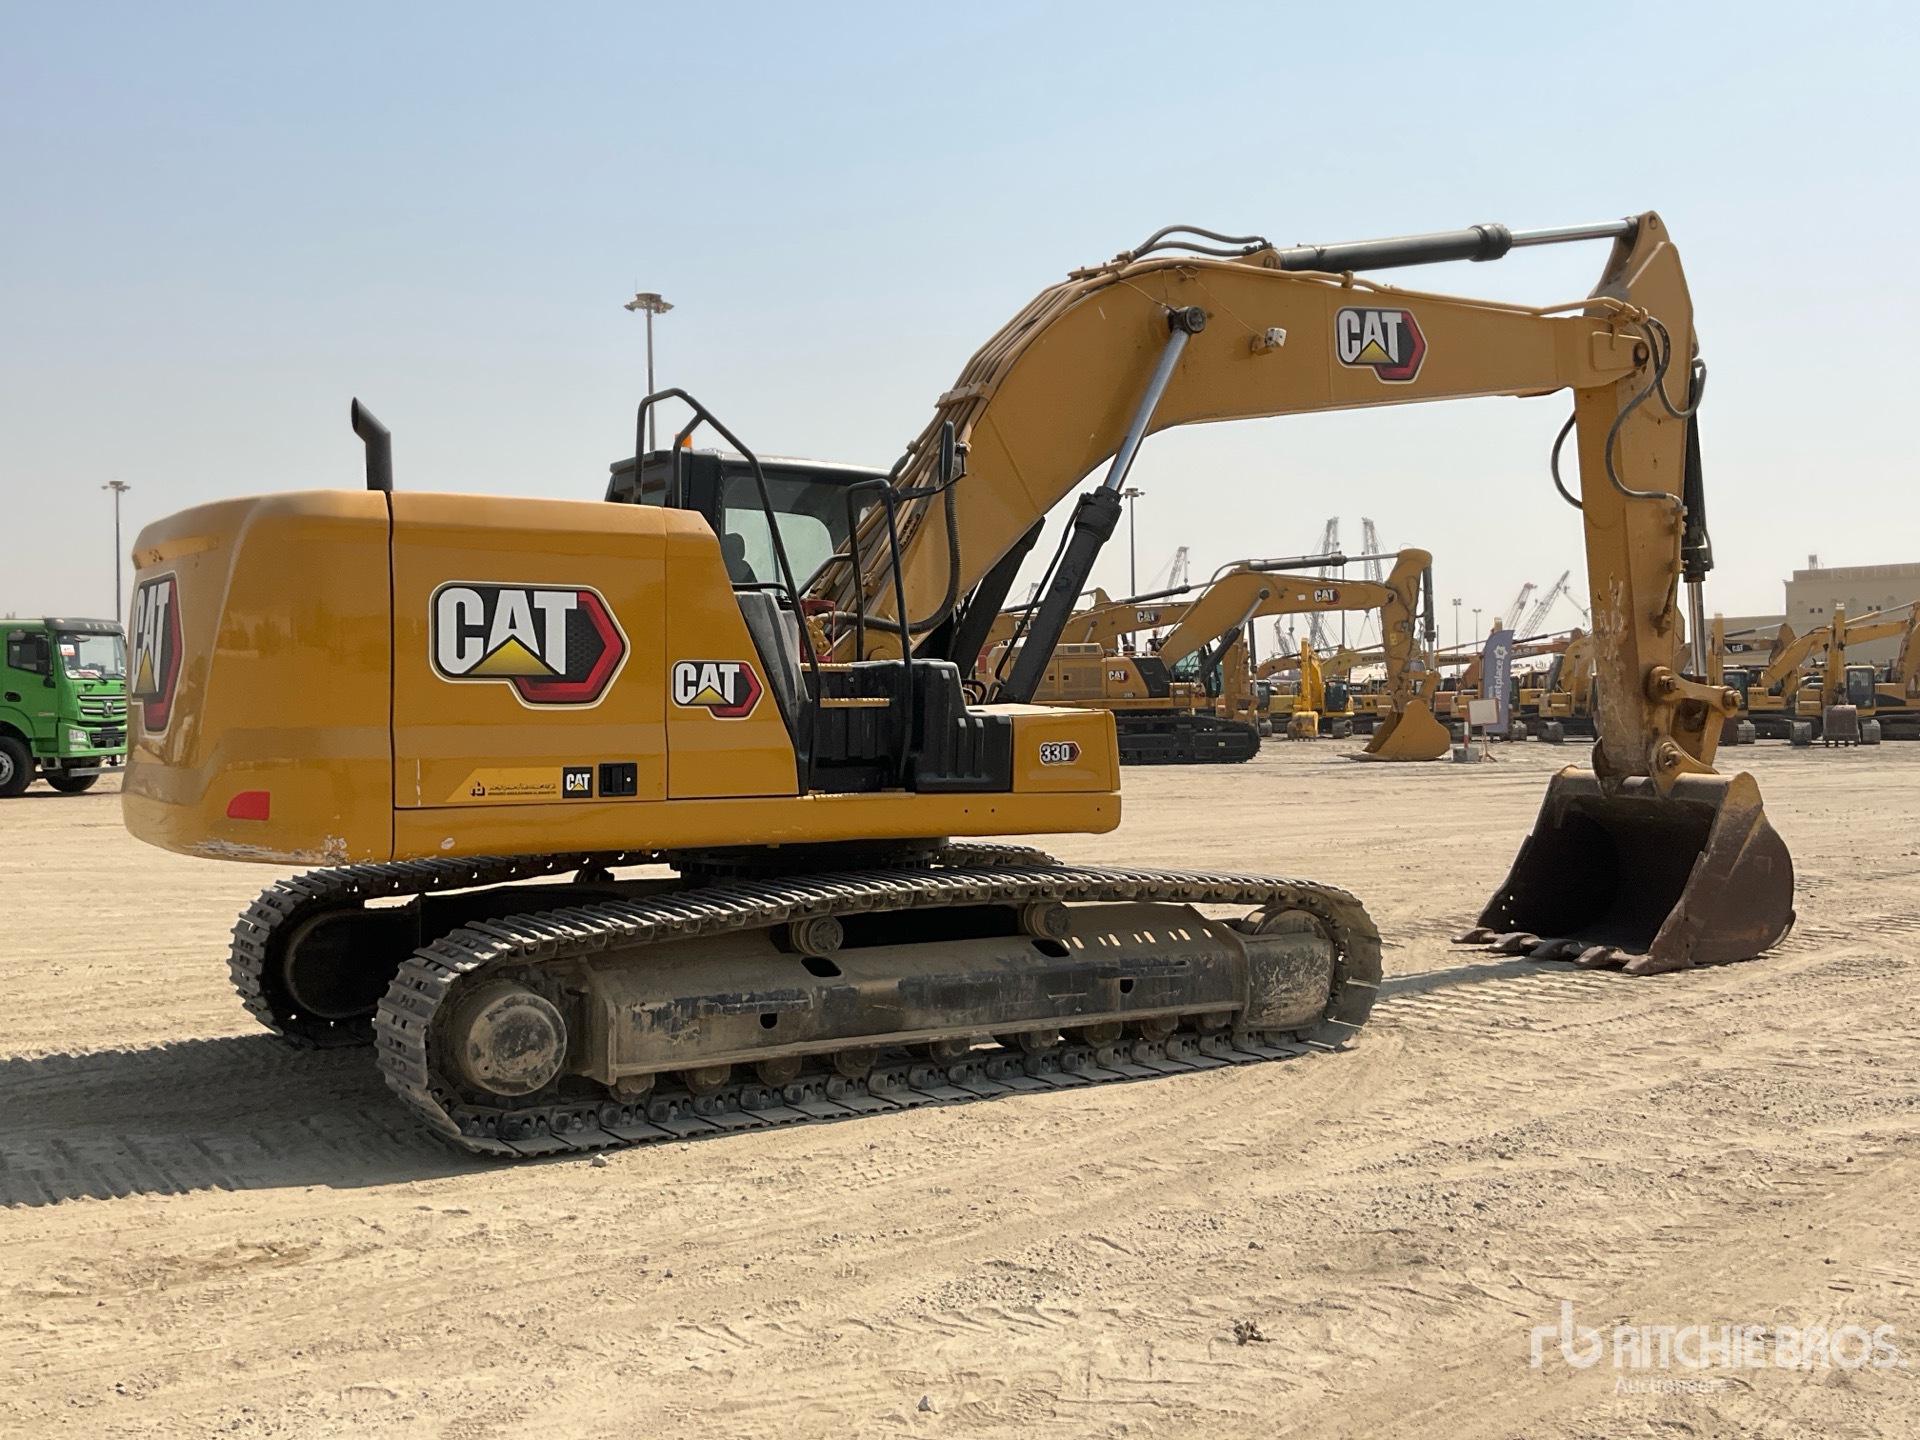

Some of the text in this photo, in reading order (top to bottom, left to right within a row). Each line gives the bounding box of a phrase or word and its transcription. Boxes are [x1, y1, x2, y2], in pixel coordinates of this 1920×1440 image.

[1338, 309, 1403, 364] CAT
[1314, 588, 1335, 602] CAT
[1136, 611, 1155, 623] CAT
[131, 581, 171, 695] CAT
[437, 587, 578, 676] CAT
[674, 662, 740, 706] CAT
[1108, 669, 1125, 681] CAT
[1041, 744, 1071, 762] 330
[565, 773, 591, 791] CAT
